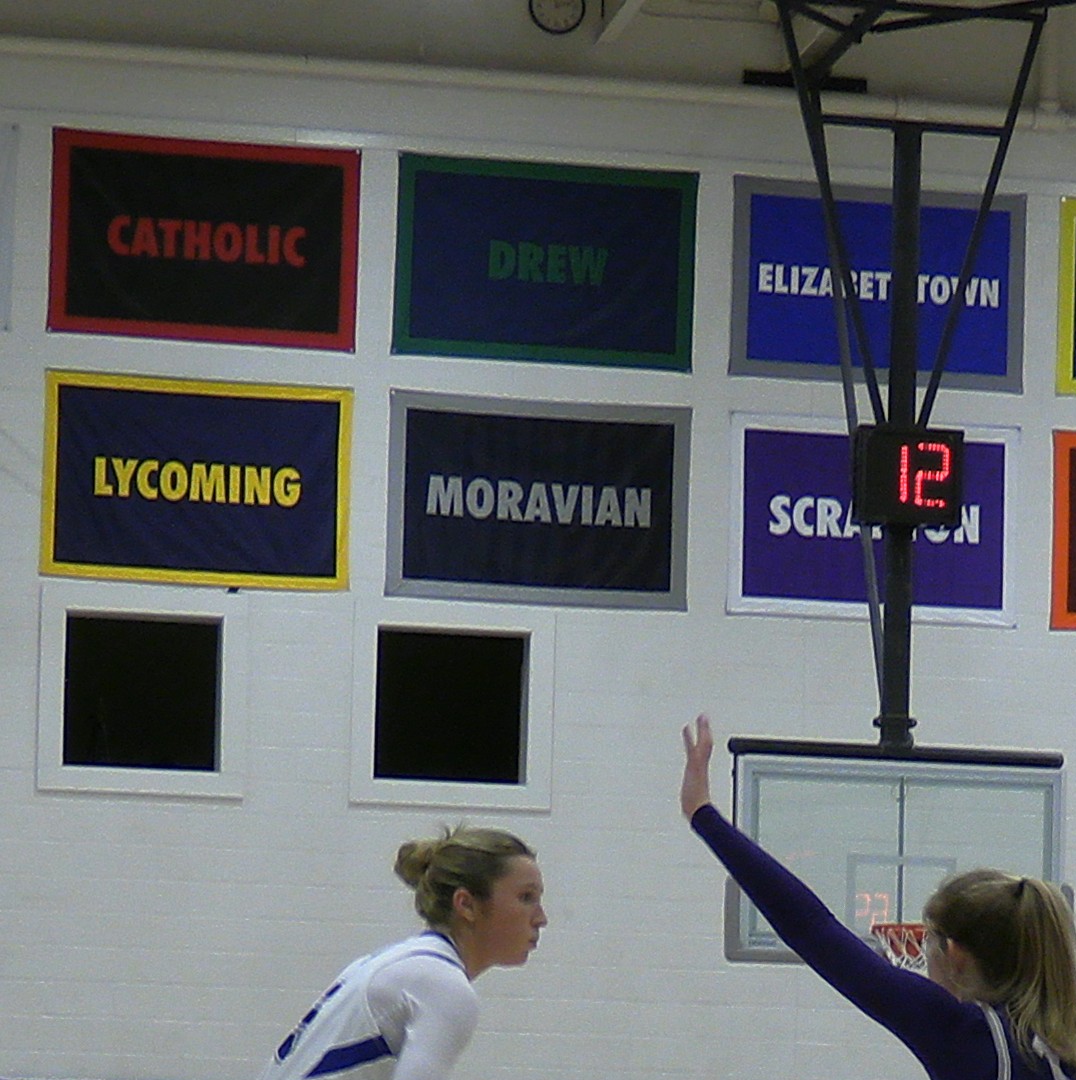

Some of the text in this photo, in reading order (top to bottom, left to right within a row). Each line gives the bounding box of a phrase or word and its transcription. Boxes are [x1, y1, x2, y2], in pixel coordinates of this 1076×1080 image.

[107, 214, 306, 268] CATHOLIC
[488, 239, 609, 286] DREW
[757, 262, 1000, 309] ELIZAETTOWN
[93, 456, 301, 507] LYCOMING
[899, 441, 951, 508] 12
[426, 475, 652, 529] MORAVIAN
